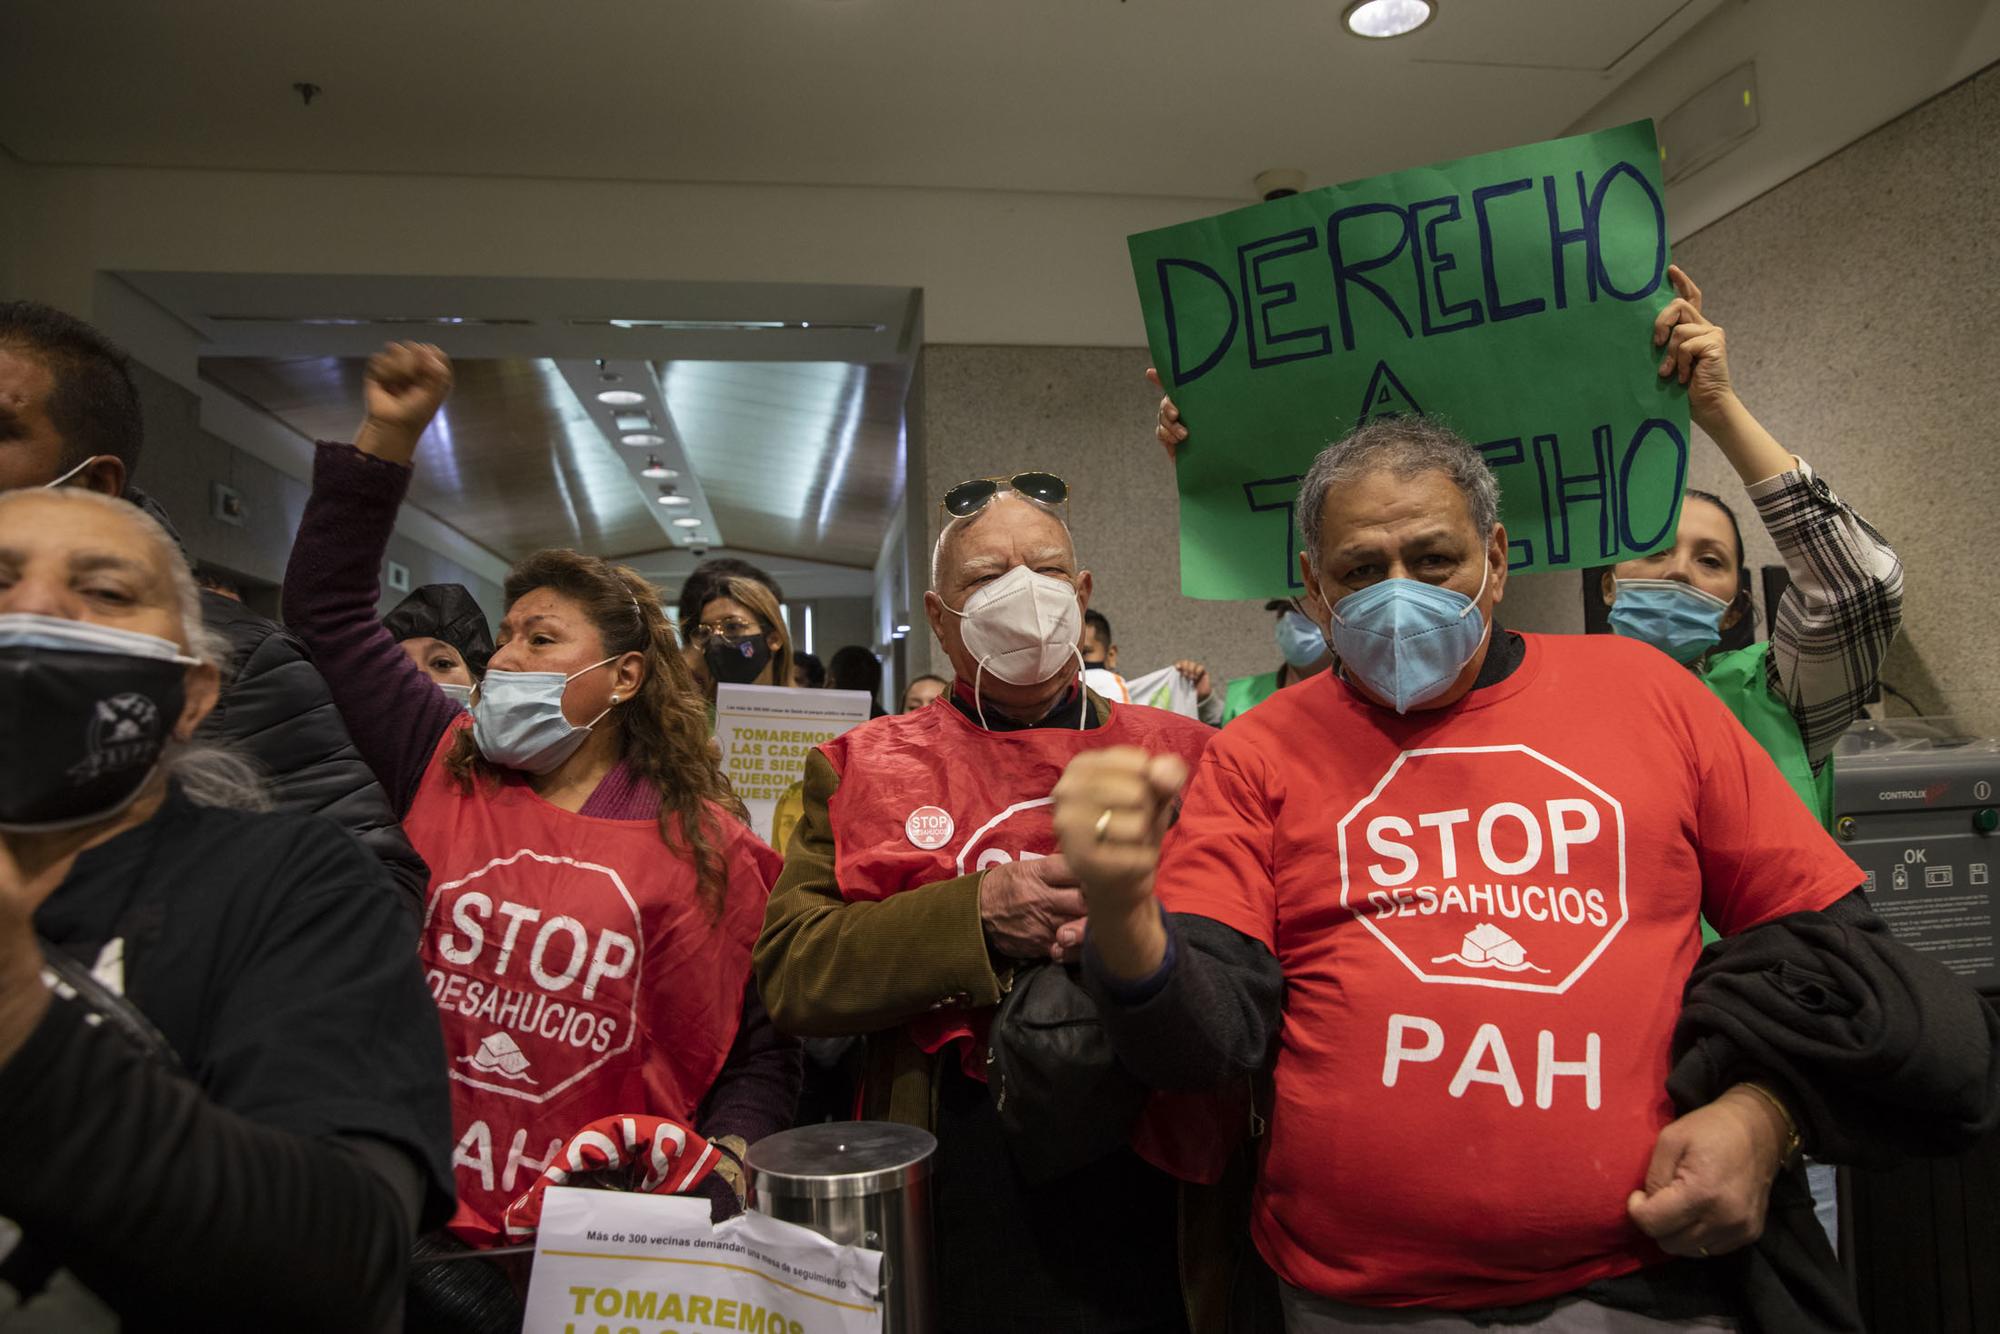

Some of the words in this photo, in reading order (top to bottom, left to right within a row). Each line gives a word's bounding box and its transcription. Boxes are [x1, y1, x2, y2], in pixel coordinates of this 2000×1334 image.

[1156, 161, 1666, 387] DERECHO
[1355, 359, 1424, 432] A
[731, 742, 762, 755] LAS
[768, 744, 809, 757] CASA
[732, 727, 835, 743] TOMAREMOS
[729, 771, 796, 786] FUERON
[730, 757, 764, 769] QUE
[912, 815, 948, 829] STOP
[1366, 798, 1601, 887] STOP
[1904, 849, 1927, 864] OK
[1367, 884, 1608, 927] DESAHUCIOS
[439, 891, 636, 1001] STOP
[1382, 1013, 1601, 1110] PAH
[453, 1120, 563, 1193] AH
[586, 1230, 609, 1241] Más
[612, 1232, 625, 1242] de
[628, 1233, 647, 1244] 300
[650, 1235, 690, 1247] vecinas
[694, 1237, 746, 1254] demandan
[781, 1262, 791, 1273] de
[793, 1267, 847, 1289] seguimiento
